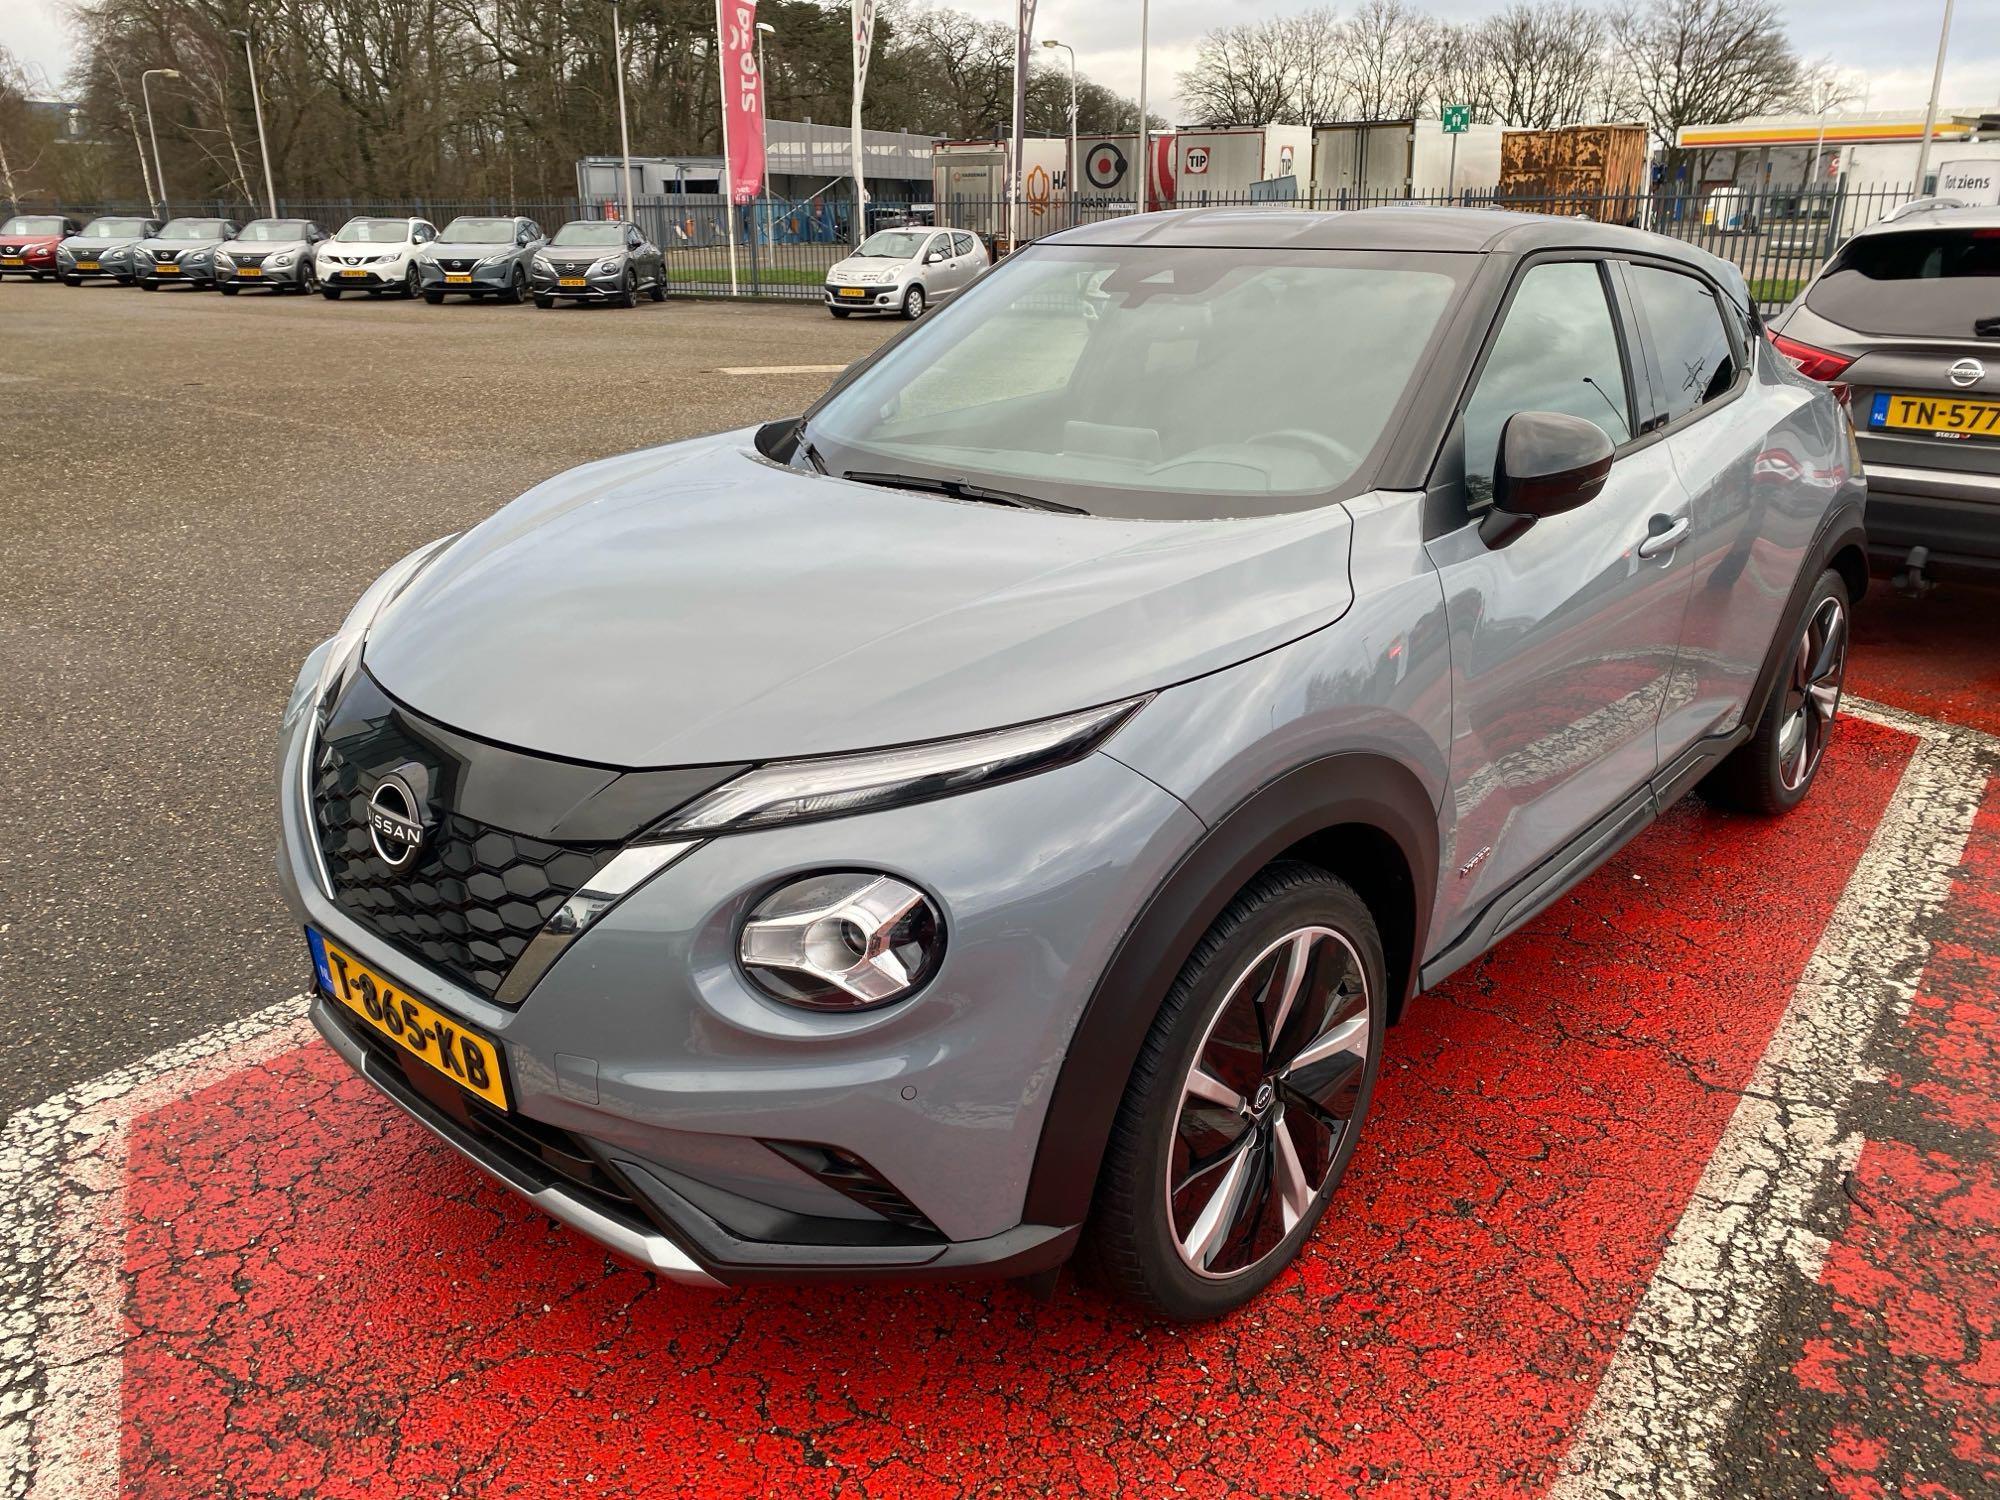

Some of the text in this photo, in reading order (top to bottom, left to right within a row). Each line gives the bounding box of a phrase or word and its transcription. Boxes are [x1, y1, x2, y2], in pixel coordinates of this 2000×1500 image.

[1189, 155, 1206, 168] TIP
[1281, 159, 1292, 175] TIP
[1957, 174, 1990, 189] ziens
[1874, 412, 1886, 421] NL
[1901, 400, 2000, 430] TN-577
[1935, 431, 1961, 440] steza
[366, 804, 421, 843] NISSAN
[329, 951, 490, 1090] T-865-KB
